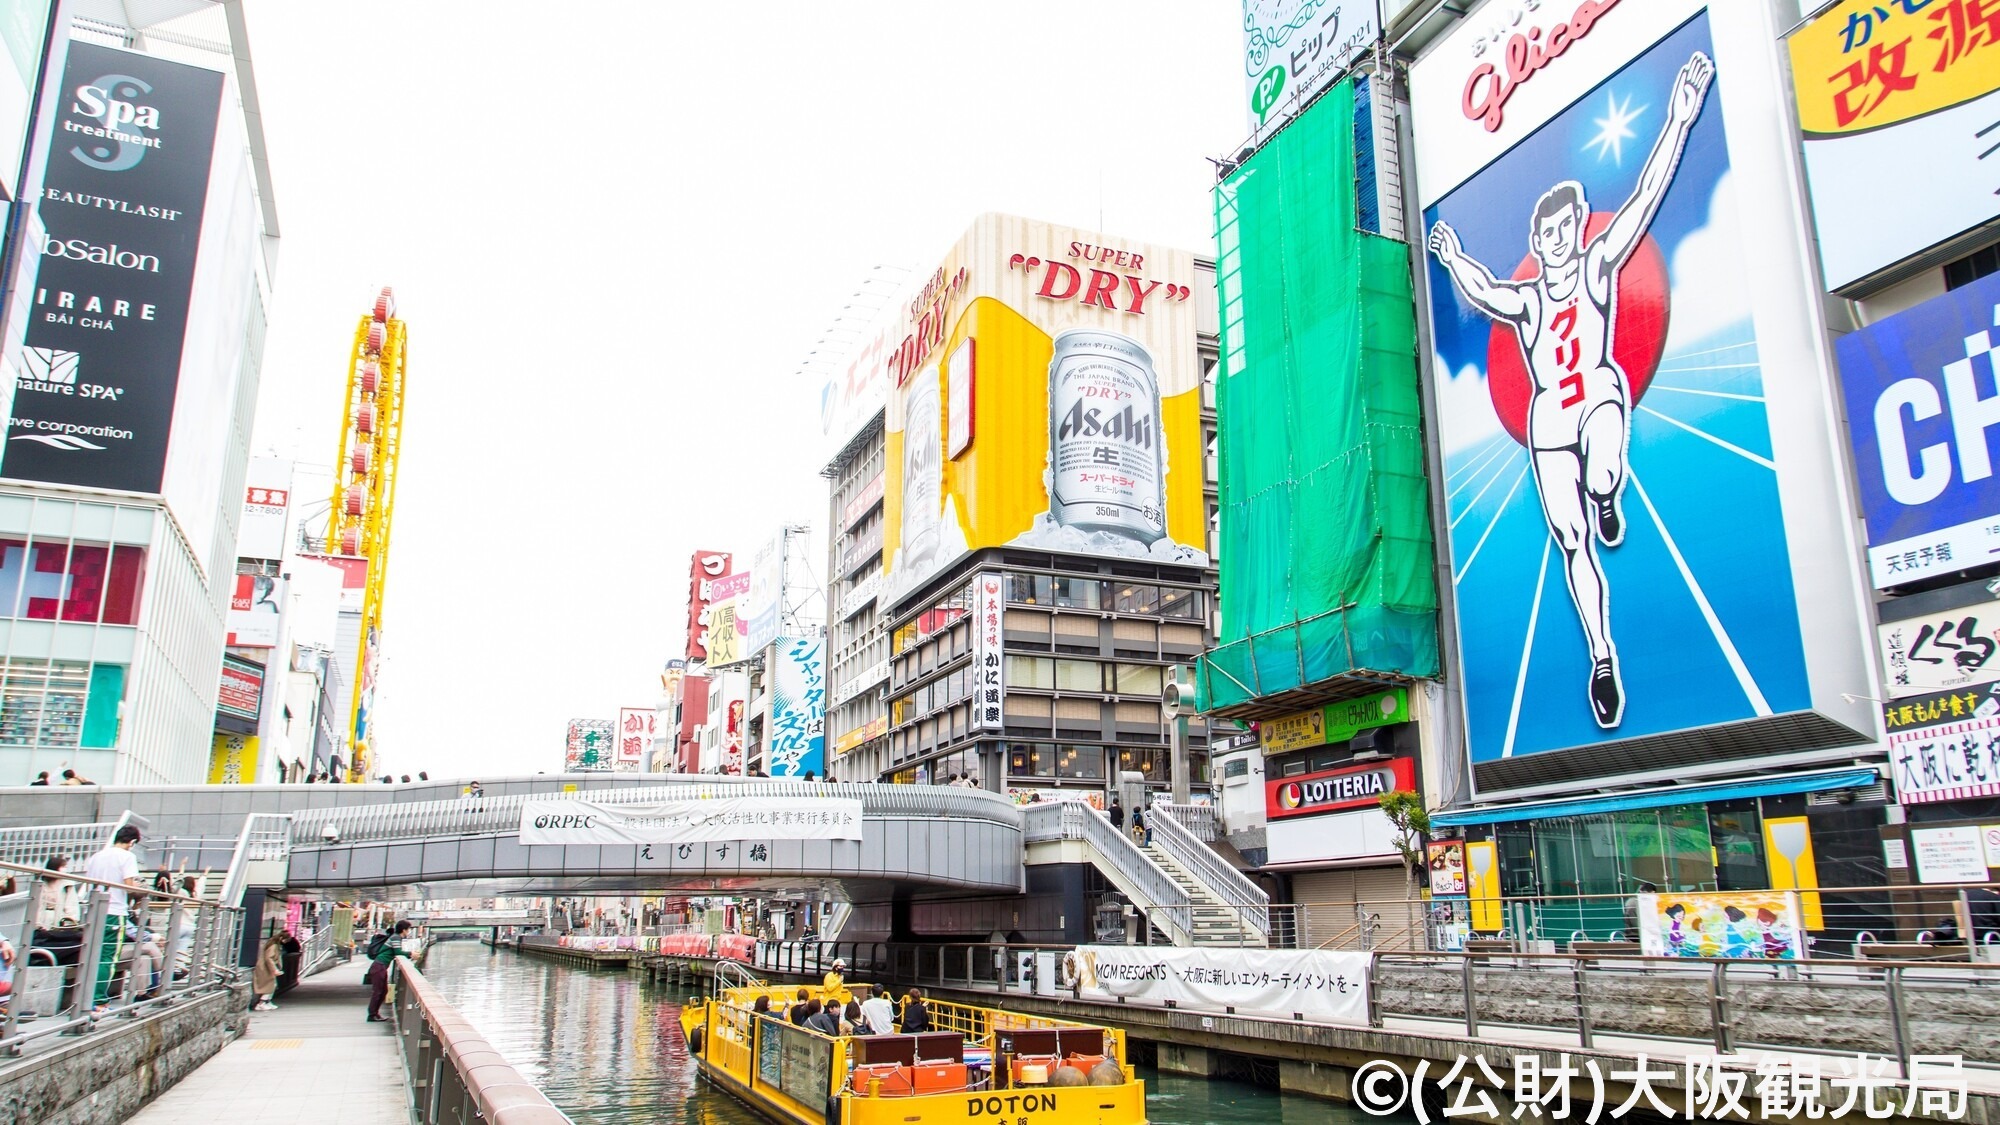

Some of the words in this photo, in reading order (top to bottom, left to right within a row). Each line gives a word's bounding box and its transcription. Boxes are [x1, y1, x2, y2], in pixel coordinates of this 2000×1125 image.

[1290, 6, 1341, 78] ピップ
[1462, 0, 1622, 132] Glico
[72, 84, 160, 132] Spa
[64, 119, 162, 149] treatment
[1067, 241, 1144, 271] SUPER
[1549, 296, 1586, 410] グリコ
[1093, 380, 1116, 388] SUPER
[1112, 376, 1135, 388] BRAND
[37, 420, 133, 440] corporation
[1059, 397, 1151, 450] Asahi
[1093, 446, 1120, 466] 生
[1080, 473, 1135, 489] スーパードライ
[1096, 506, 1119, 518] 350ml
[1143, 504, 1162, 526] お酒
[1886, 542, 1953, 575] 天気予報
[711, 608, 724, 664] バイト
[722, 605, 735, 660] 高収入
[985, 597, 998, 647] 本場の味
[1908, 617, 1996, 673] くくる
[985, 652, 1000, 722] かに道楽
[1885, 692, 1979, 728] 大阪もんを食す
[1303, 773, 1384, 802] LOTTERIA
[534, 813, 597, 830] ORPEC
[608, 816, 696, 829] 一般社団法人
[701, 811, 853, 827] 大阪活性化事業実行委員会
[641, 843, 768, 863] えびす橋
[1095, 963, 1118, 980] MGM
[1119, 964, 1167, 981] RESORTS
[967, 1093, 1056, 1117] DOTON
